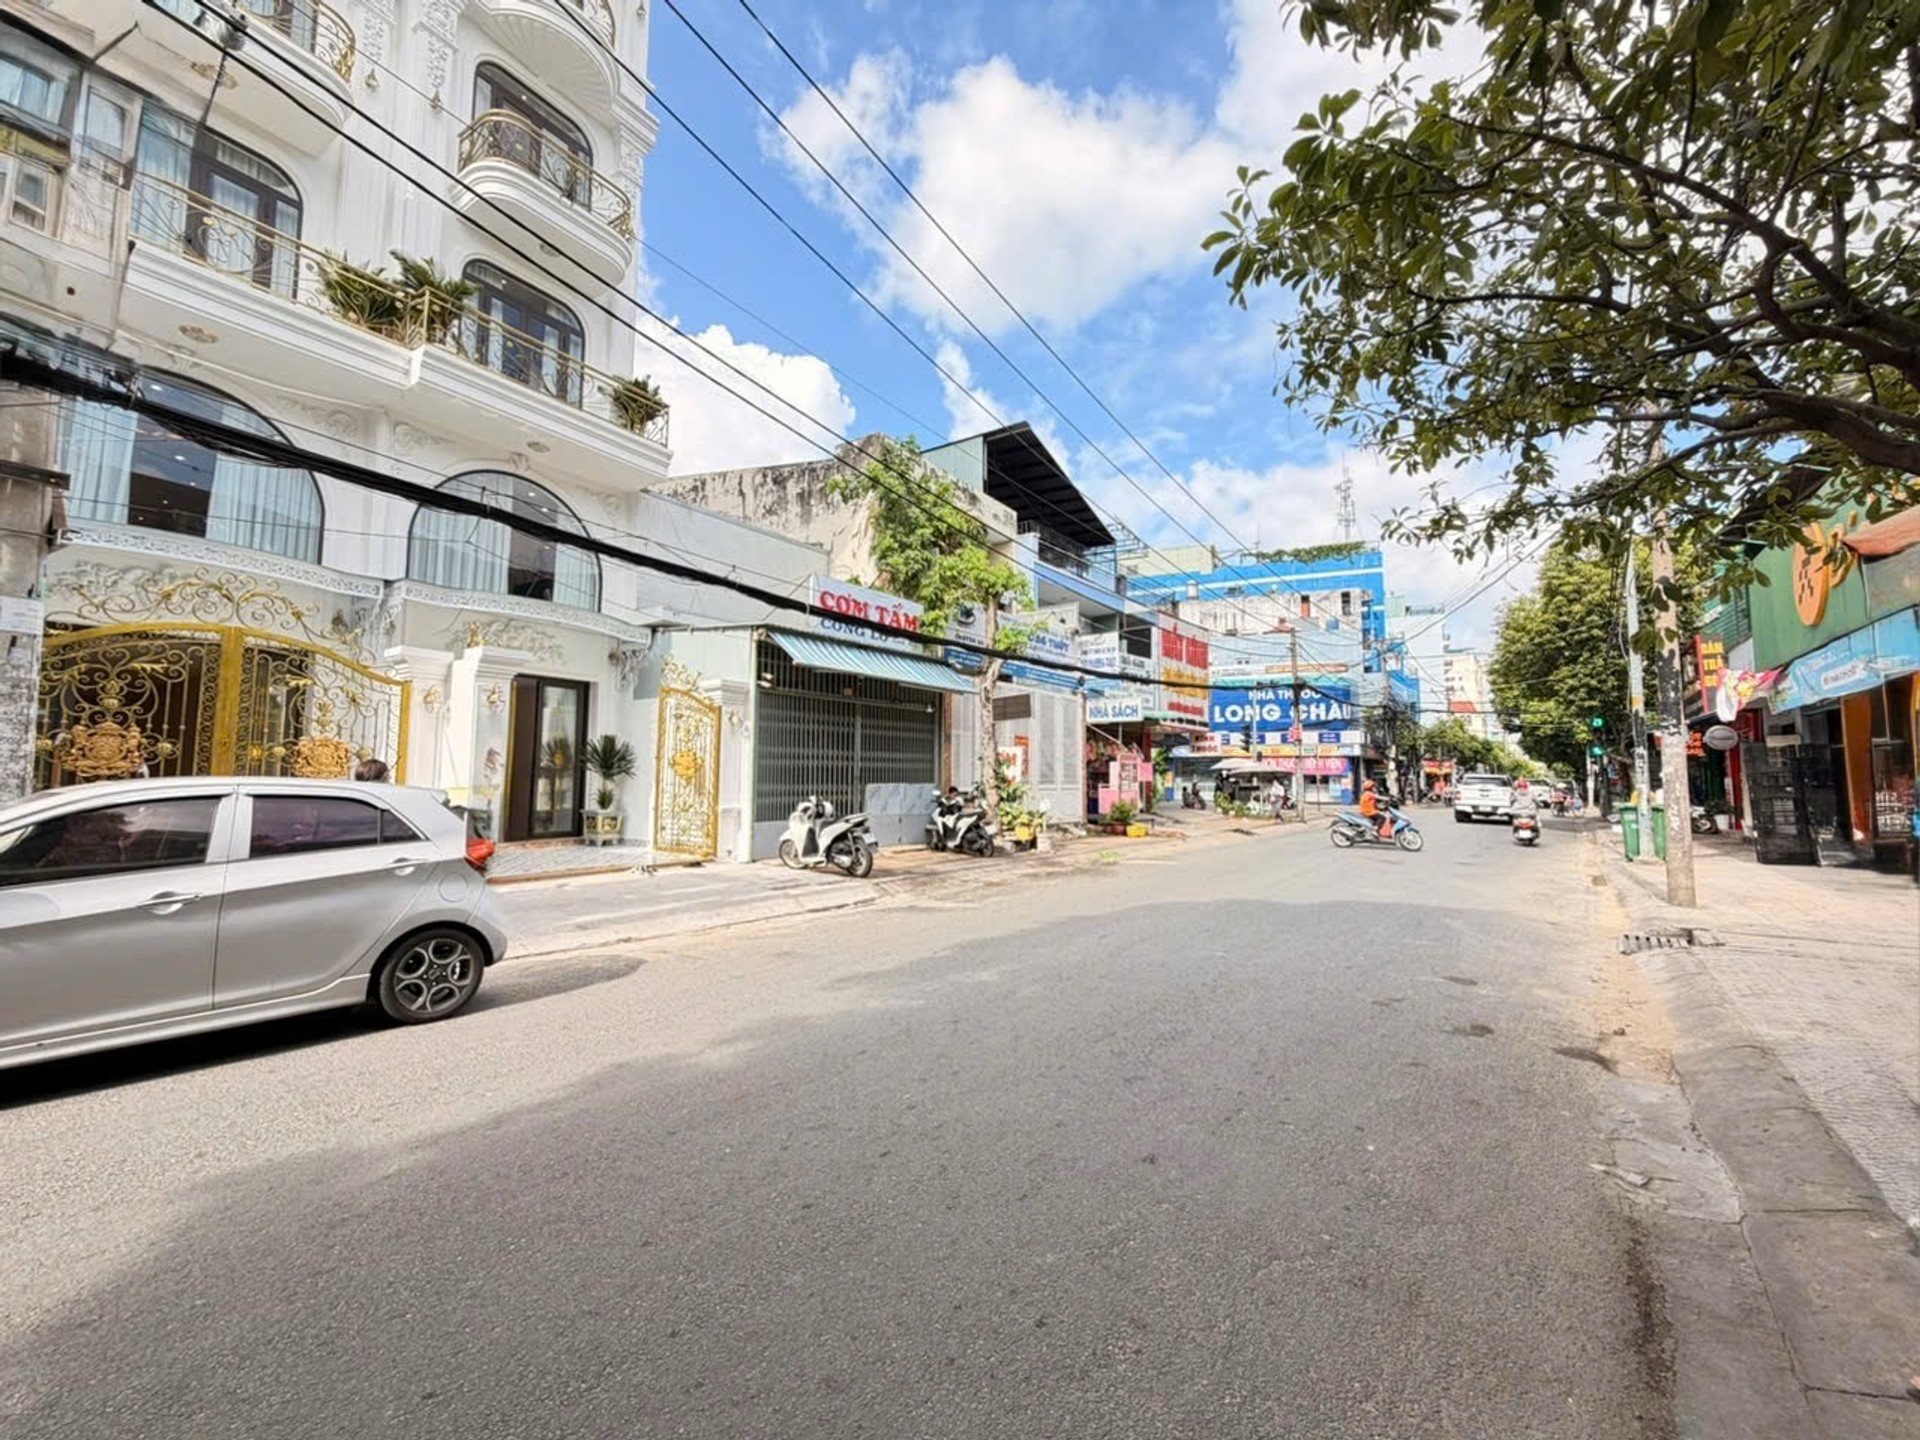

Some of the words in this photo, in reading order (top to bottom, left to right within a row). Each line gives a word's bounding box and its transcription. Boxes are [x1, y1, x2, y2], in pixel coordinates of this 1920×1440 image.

[820, 591, 869, 618] CƠM
[875, 602, 920, 633] TẤM
[1249, 688, 1275, 700] NHÀ
[1089, 701, 1110, 719] NHÀ
[1111, 701, 1139, 718] SÁCH
[1213, 703, 1281, 722] LONG
